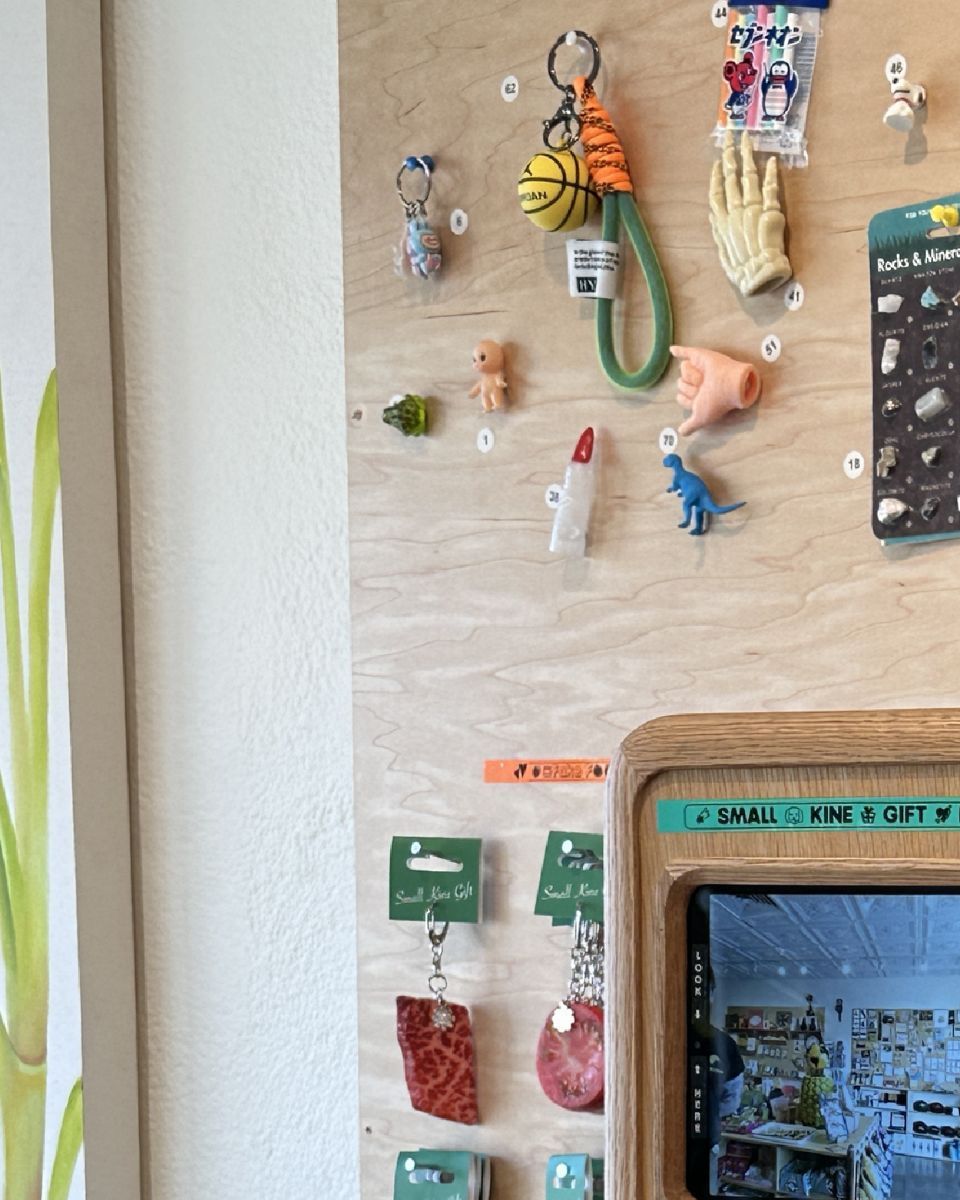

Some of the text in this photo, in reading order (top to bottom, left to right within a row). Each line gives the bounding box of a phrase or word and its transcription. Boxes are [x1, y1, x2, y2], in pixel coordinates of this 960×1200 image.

[877, 254, 909, 272] Rocks
[912, 251, 922, 267] &
[766, 341, 777, 356] 51
[848, 458, 861, 471] 18
[717, 805, 778, 825] SMALL
[810, 805, 853, 824] KINE
[882, 804, 927, 824] GIFT
